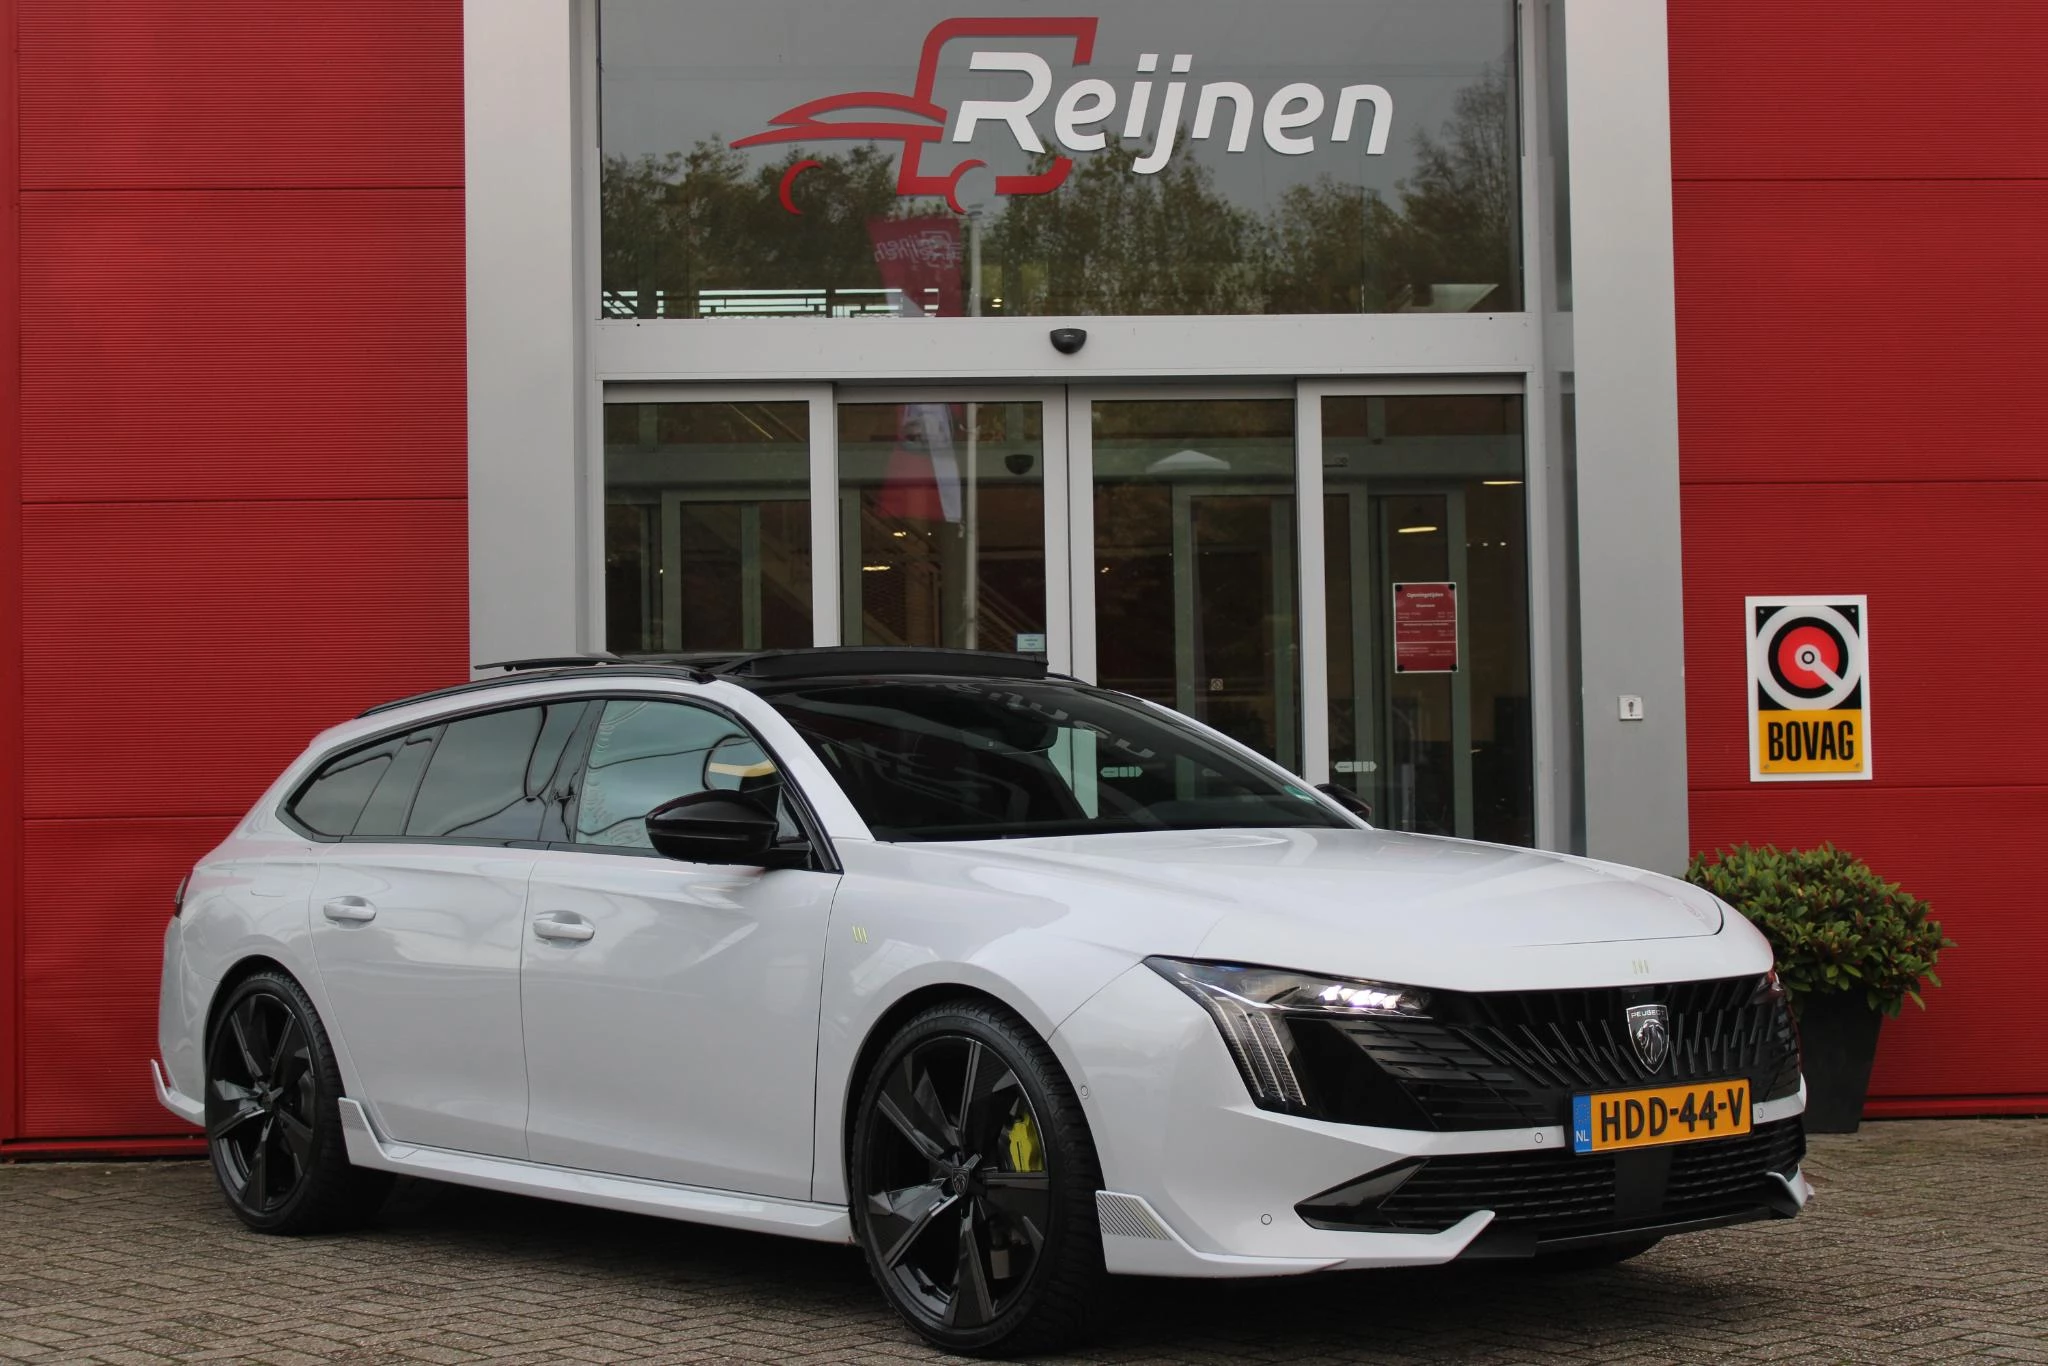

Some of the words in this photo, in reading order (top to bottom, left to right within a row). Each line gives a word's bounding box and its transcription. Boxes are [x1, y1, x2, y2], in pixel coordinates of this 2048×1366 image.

[952, 51, 1394, 174] Reijnen
[1768, 720, 1854, 762] BOVAG
[1630, 1009, 1665, 1018] PEUGEOT
[1576, 1130, 1590, 1142] NL
[1600, 1087, 1744, 1143] HDD-44-V
